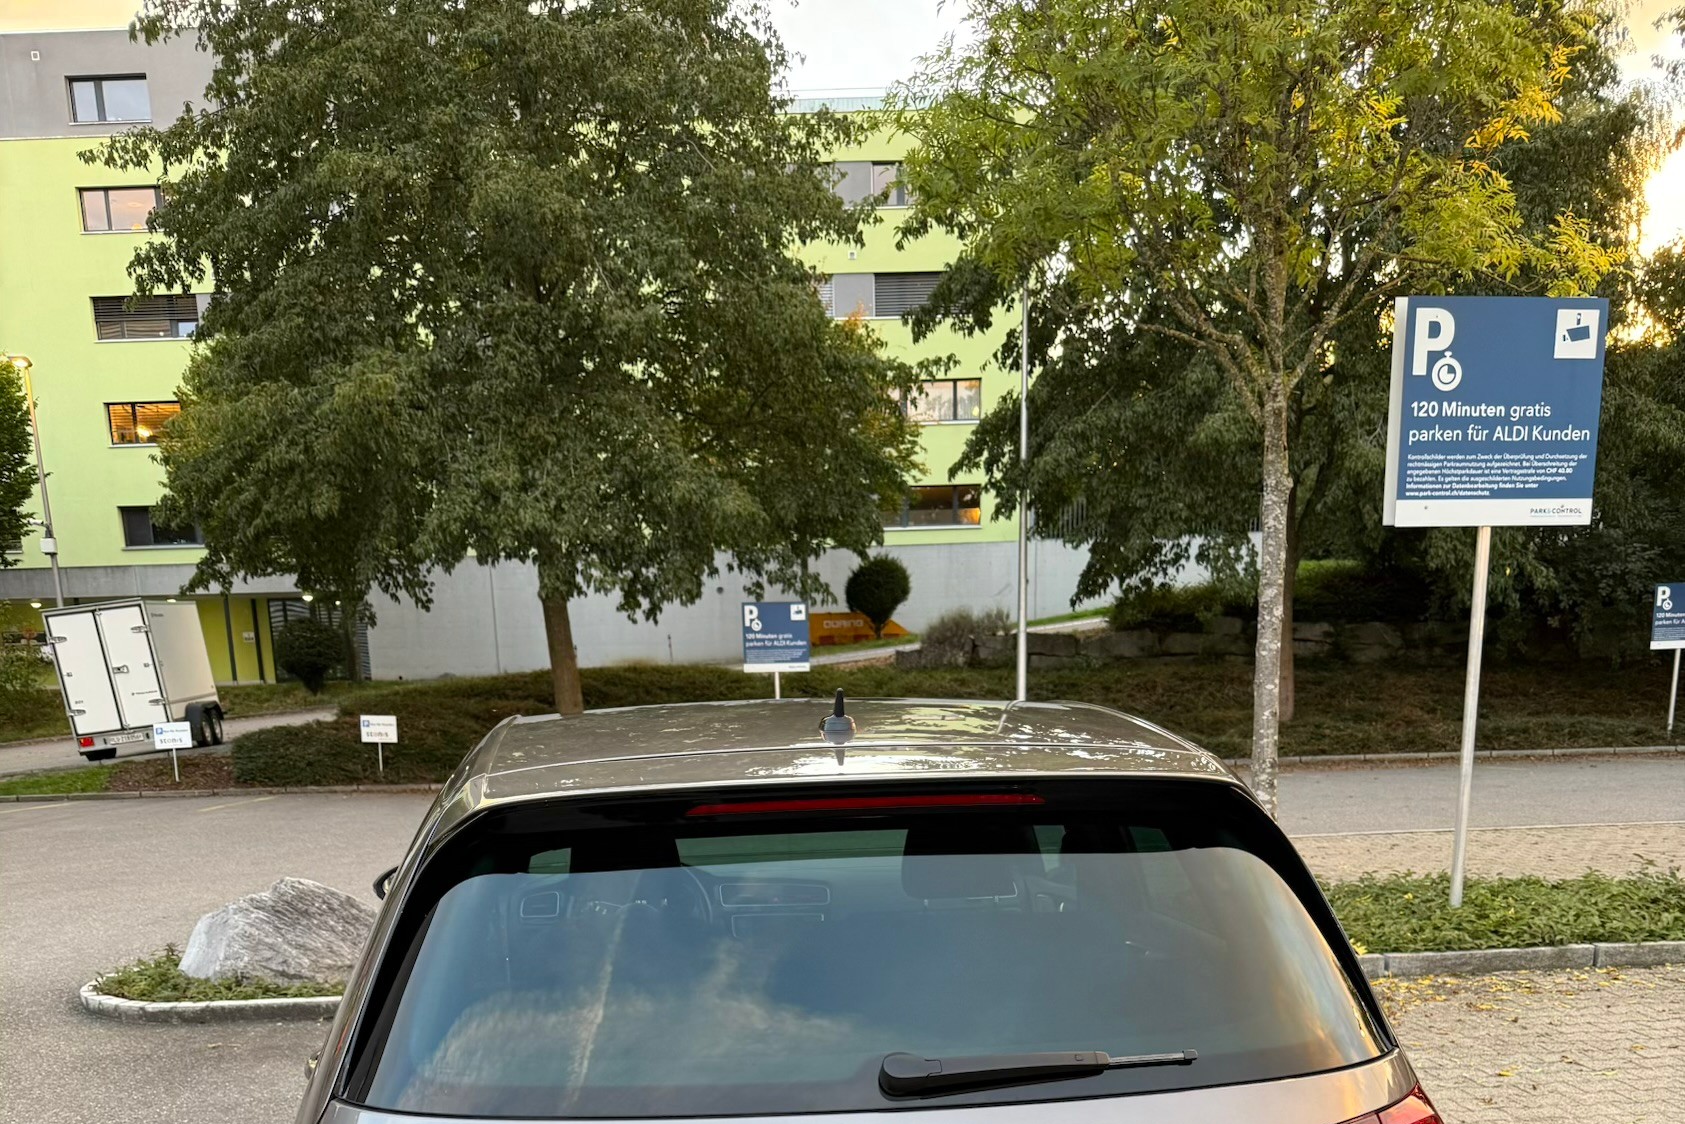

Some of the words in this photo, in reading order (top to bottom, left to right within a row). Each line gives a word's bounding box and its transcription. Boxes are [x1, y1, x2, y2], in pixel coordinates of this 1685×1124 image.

[1412, 307, 1456, 376] P
[1410, 401, 1439, 417] 120
[1442, 401, 1505, 417] Minuten
[1510, 402, 1551, 421] gratis
[1408, 425, 1462, 445] parken
[1467, 424, 1489, 441] für
[1493, 426, 1528, 441] ALDI
[1532, 424, 1590, 441] Kunden
[1656, 586, 1671, 606] P
[744, 605, 759, 627] P
